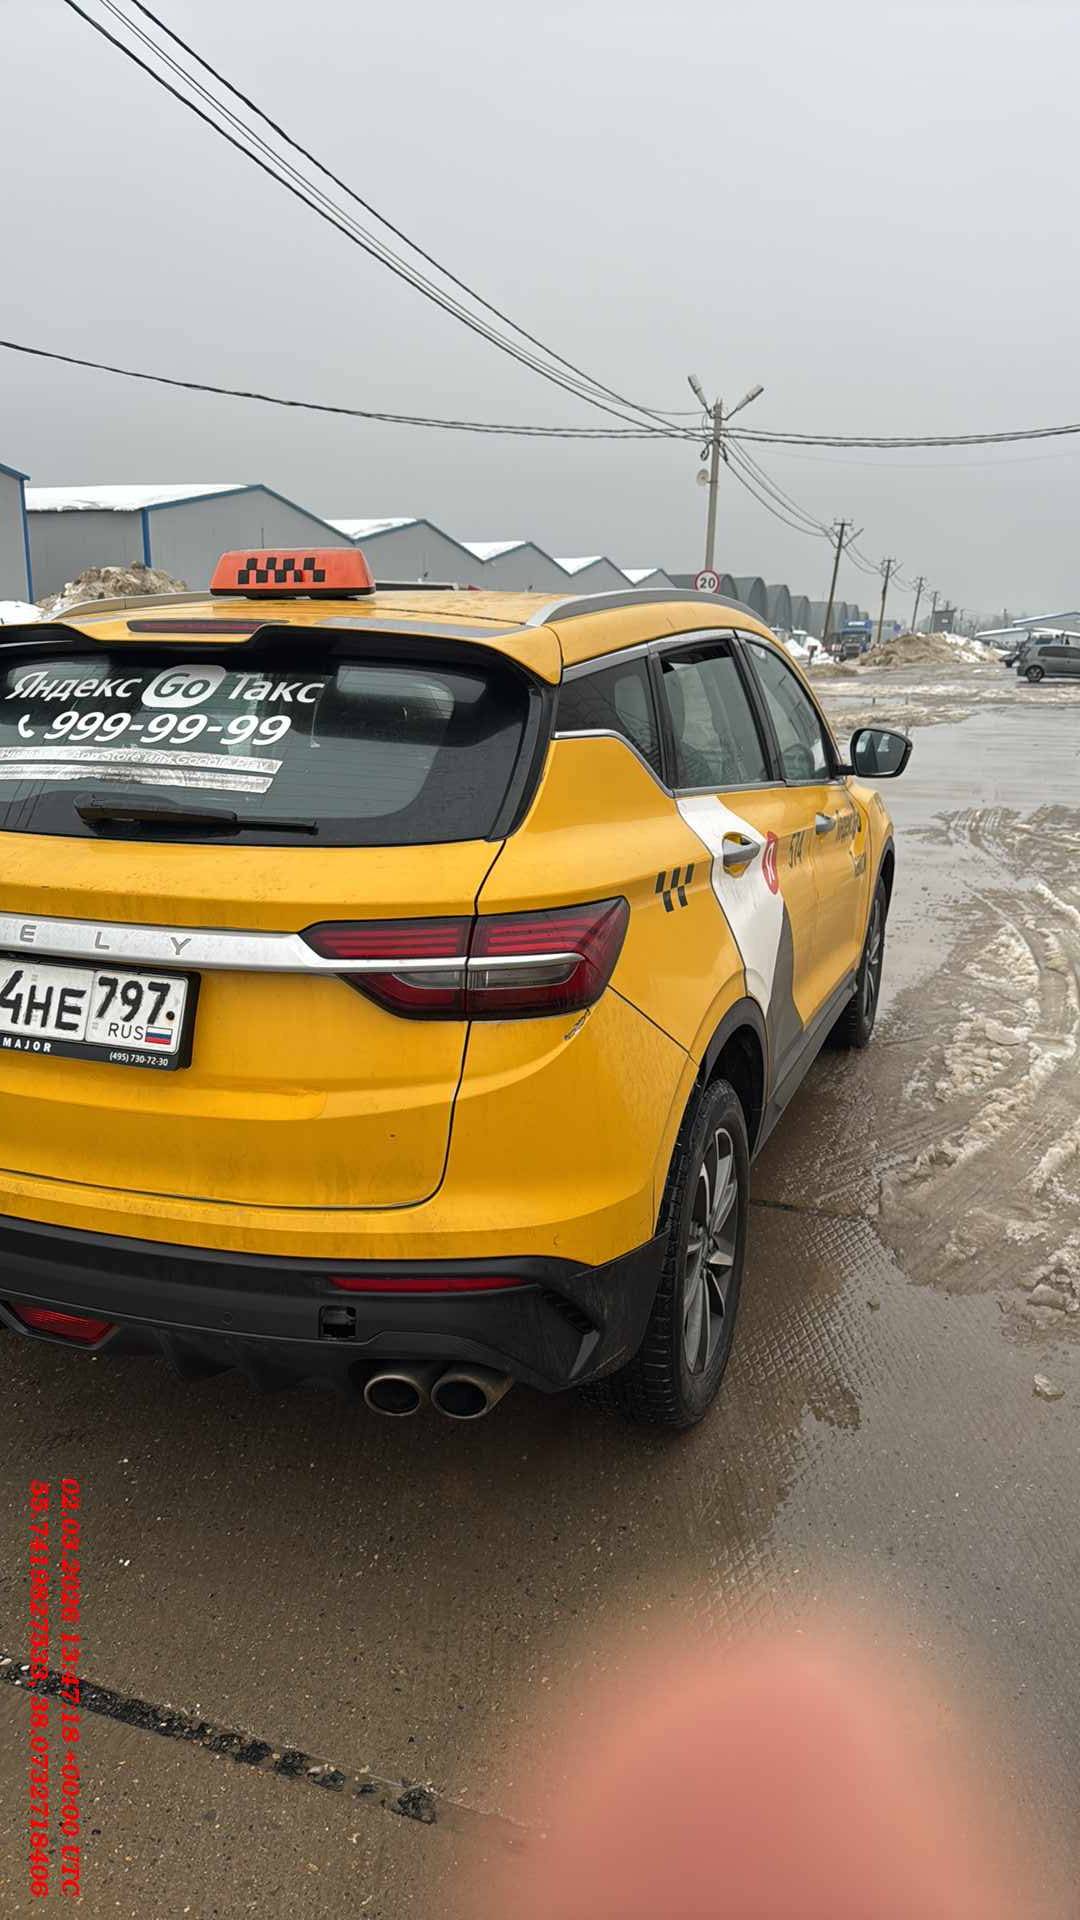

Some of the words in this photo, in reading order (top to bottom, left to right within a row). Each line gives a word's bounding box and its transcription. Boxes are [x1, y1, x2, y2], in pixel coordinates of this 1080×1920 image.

[700, 577, 716, 589] 20
[5, 671, 143, 701] Яндекс
[154, 672, 212, 699] Go
[228, 673, 325, 703] Такс
[44, 711, 292, 746] 999-99-99
[97, 976, 172, 1026] 797
[108, 1022, 145, 1041] RUS
[2, 1036, 52, 1053] MAJOR
[109, 1051, 129, 1064] (495)
[130, 1054, 169, 1067] 730-72-30
